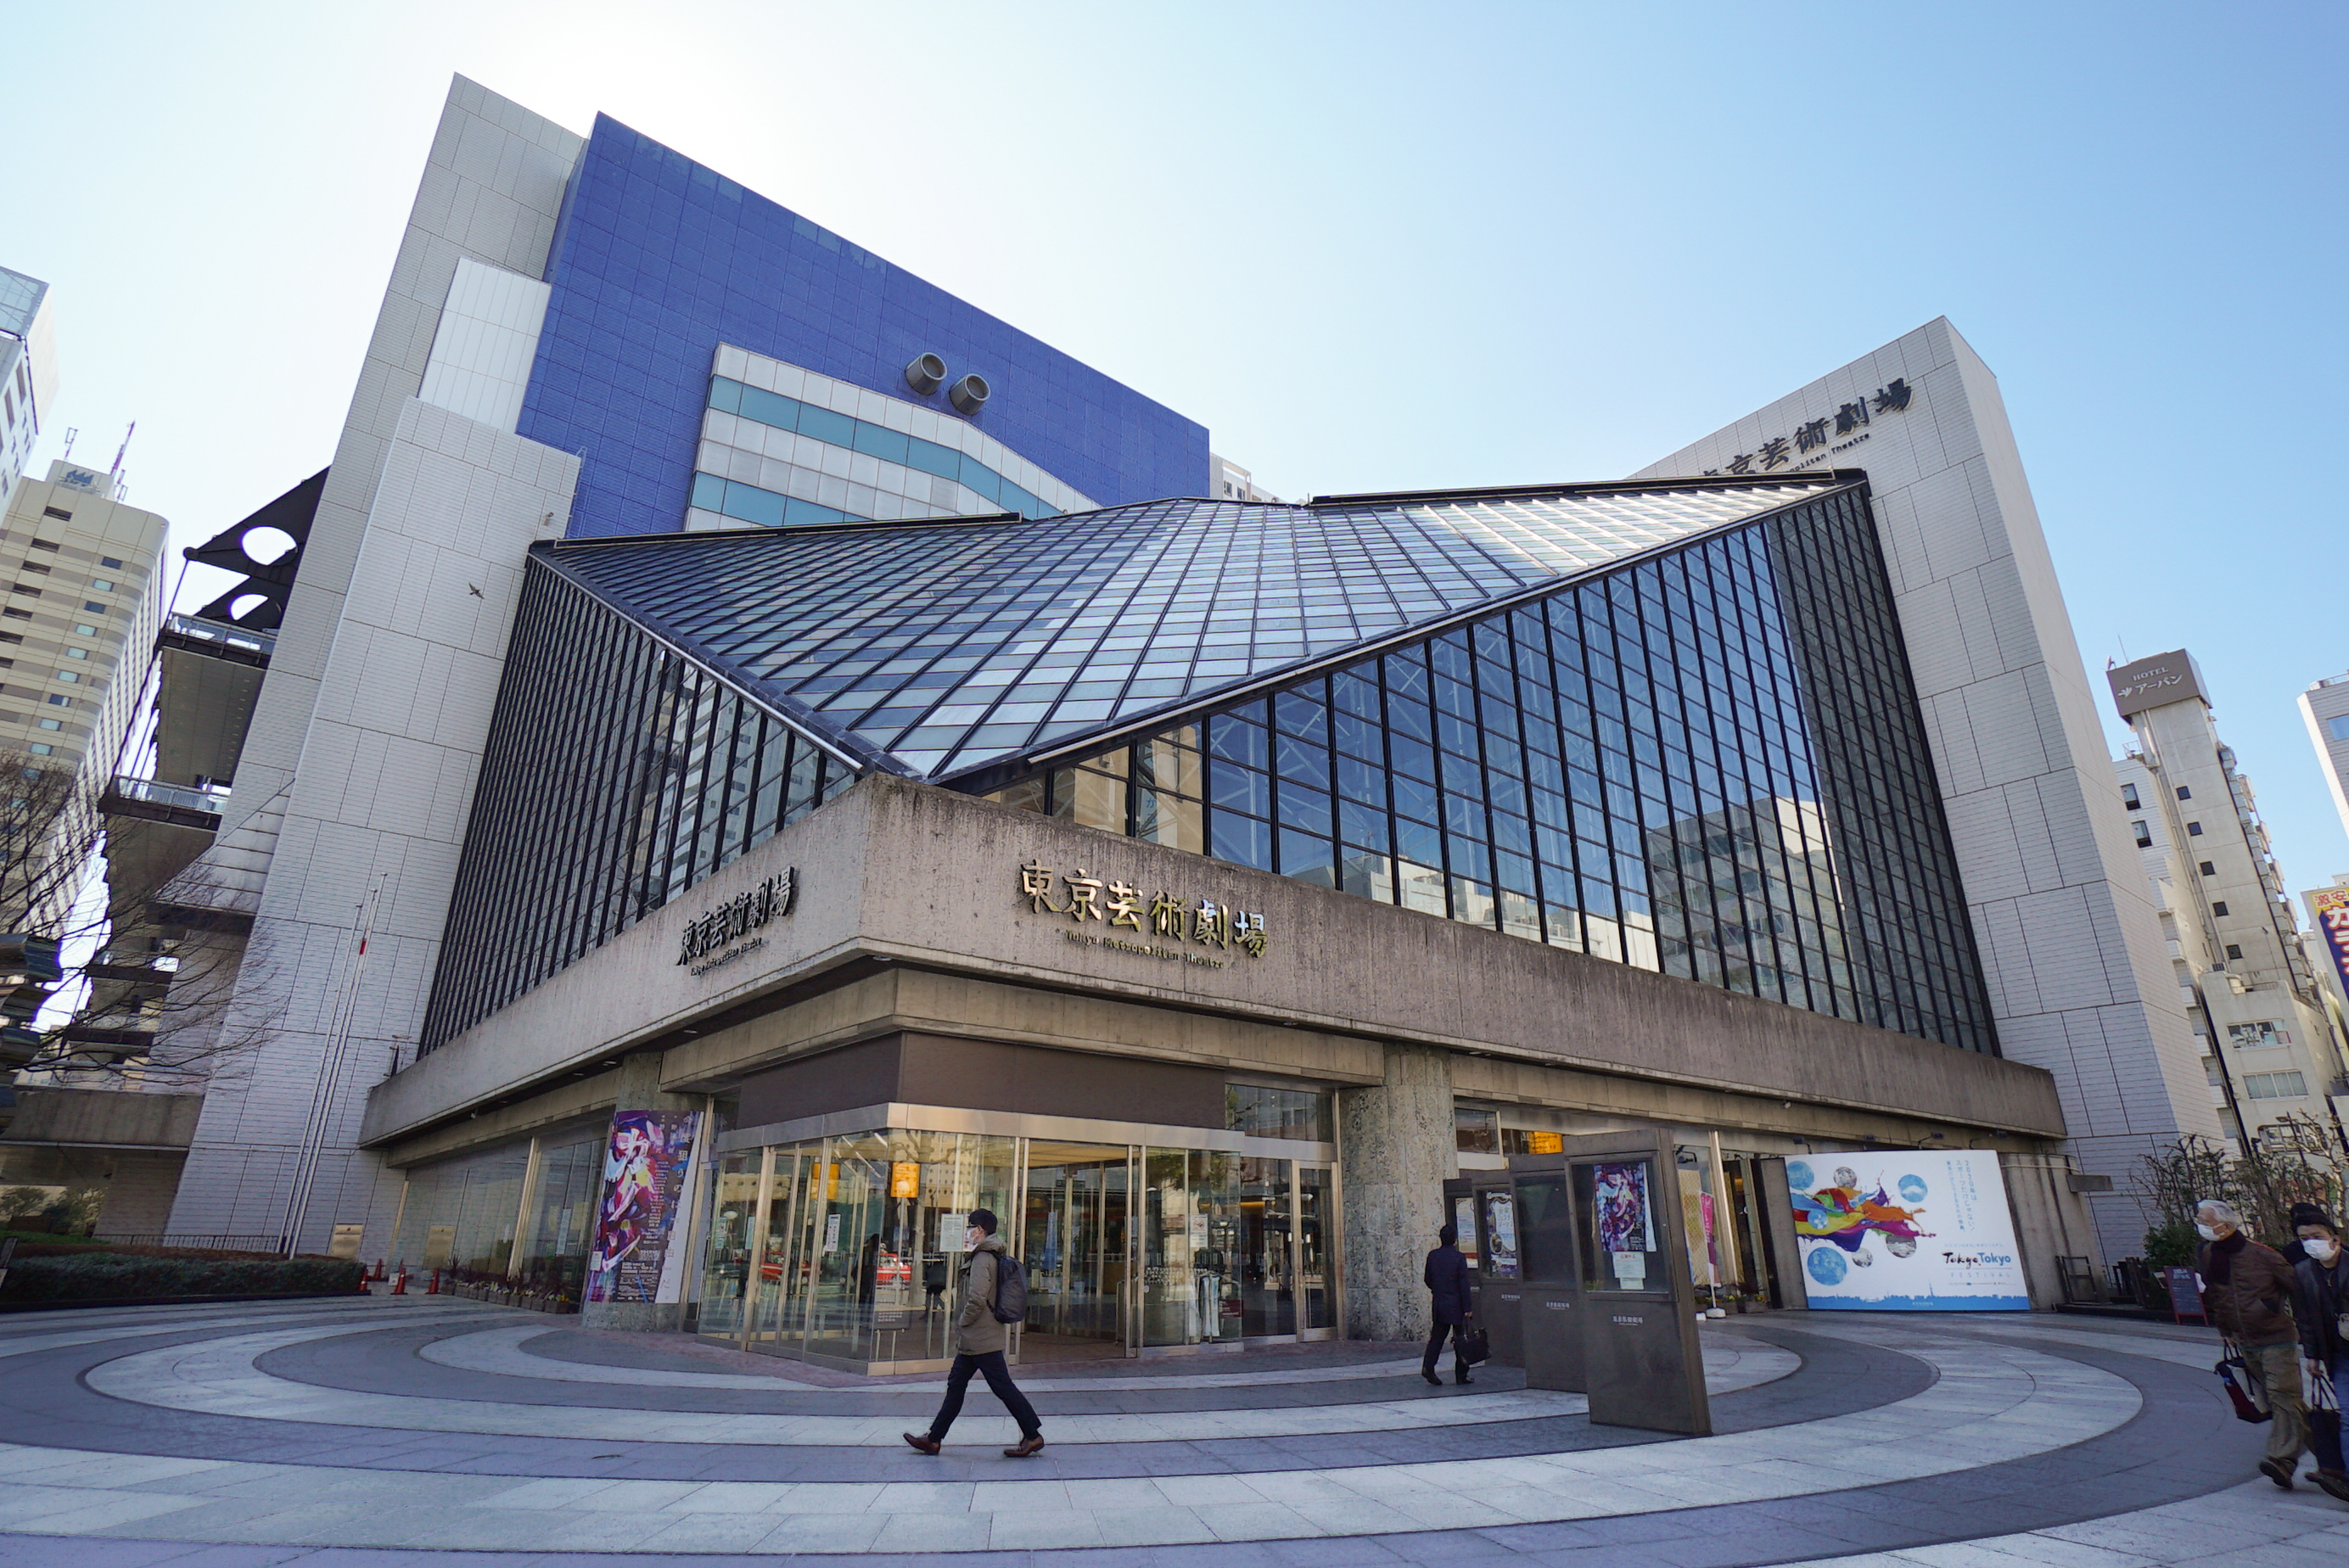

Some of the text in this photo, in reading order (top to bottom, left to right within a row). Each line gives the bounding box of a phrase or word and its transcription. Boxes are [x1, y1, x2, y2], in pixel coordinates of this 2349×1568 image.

[2133, 667, 2169, 681] HOTEL
[2134, 674, 2183, 695] アーバン
[2314, 890, 2348, 906] 激安
[676, 865, 795, 966] 東京芸術劇場
[1020, 858, 1269, 958] 東京芸術劇場
[1977, 1252, 2011, 1266] Tokyo
